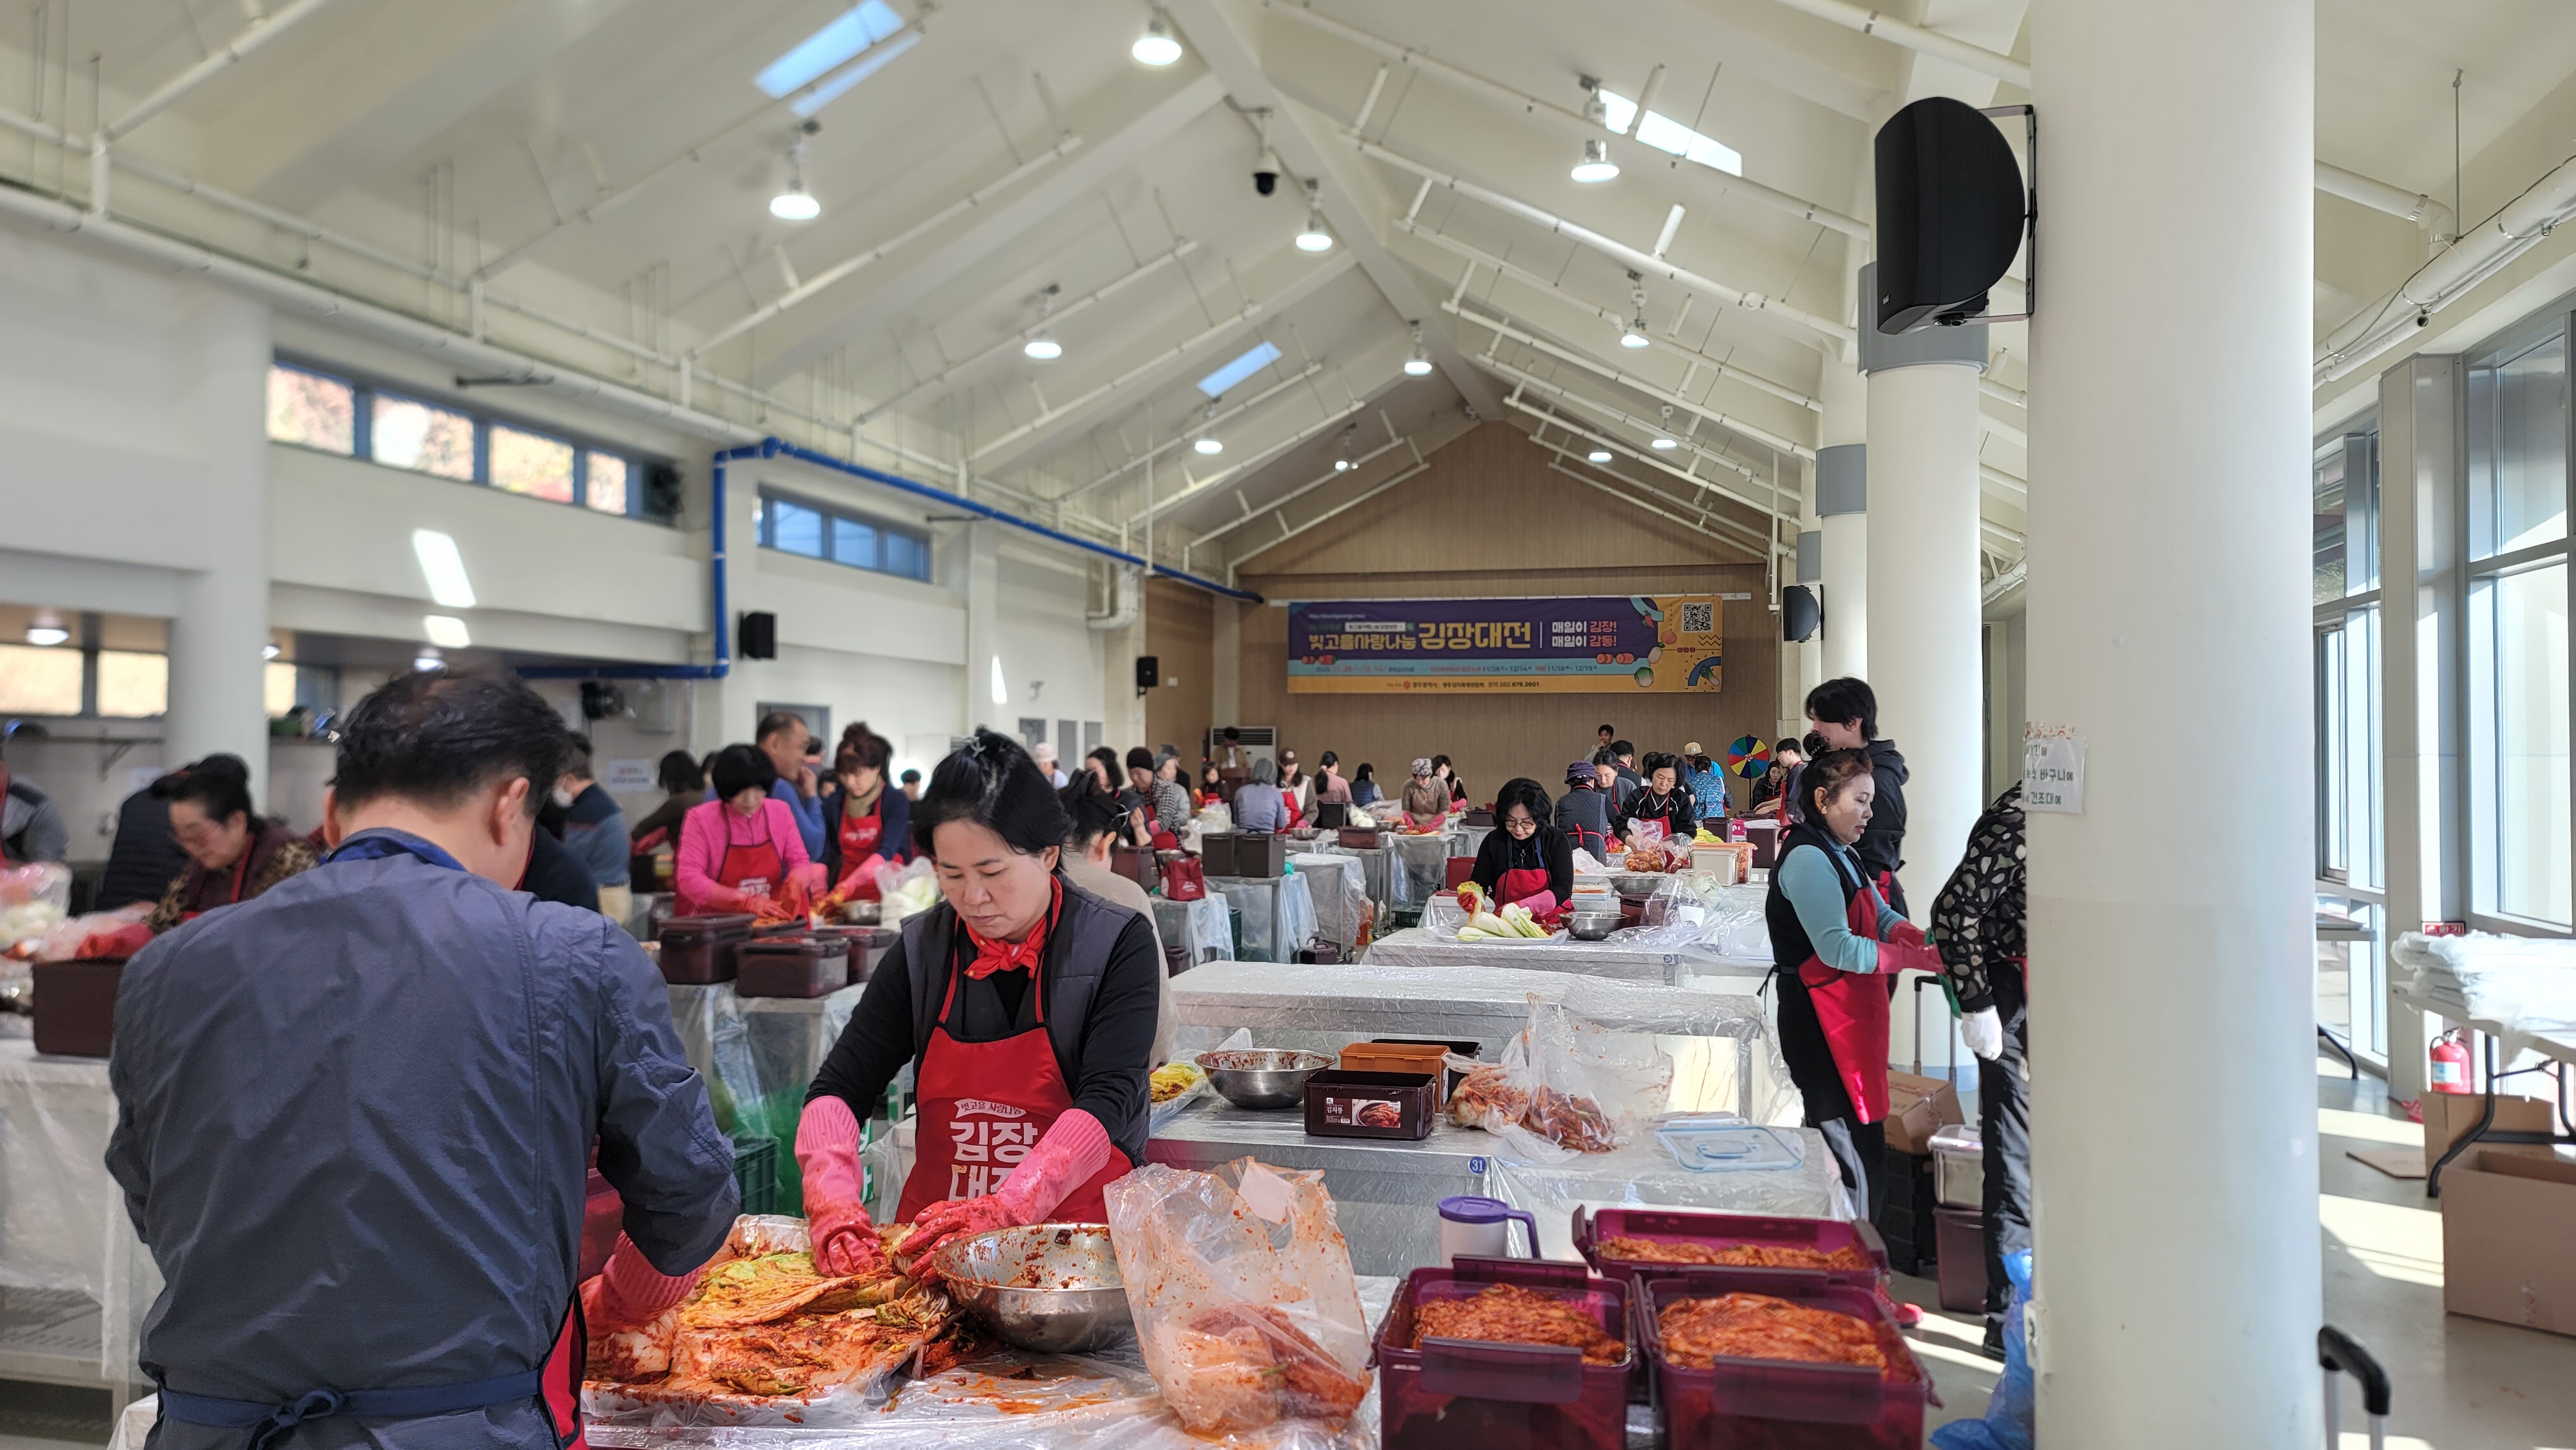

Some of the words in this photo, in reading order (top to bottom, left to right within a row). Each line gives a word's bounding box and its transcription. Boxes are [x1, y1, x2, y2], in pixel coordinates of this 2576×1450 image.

[1551, 621, 1587, 634] 매일이
[1589, 621, 1618, 633] 김장!
[1418, 622, 1531, 650] 김장대전
[1551, 636, 1587, 648] 매일이
[1589, 635, 1617, 647] 감동!
[2040, 768, 2074, 782] 바구니에
[2031, 791, 2061, 805] 건조대에
[1326, 1106, 1344, 1115] 김치통
[950, 1122, 1038, 1163] 김장
[1472, 1158, 1484, 1171] 31
